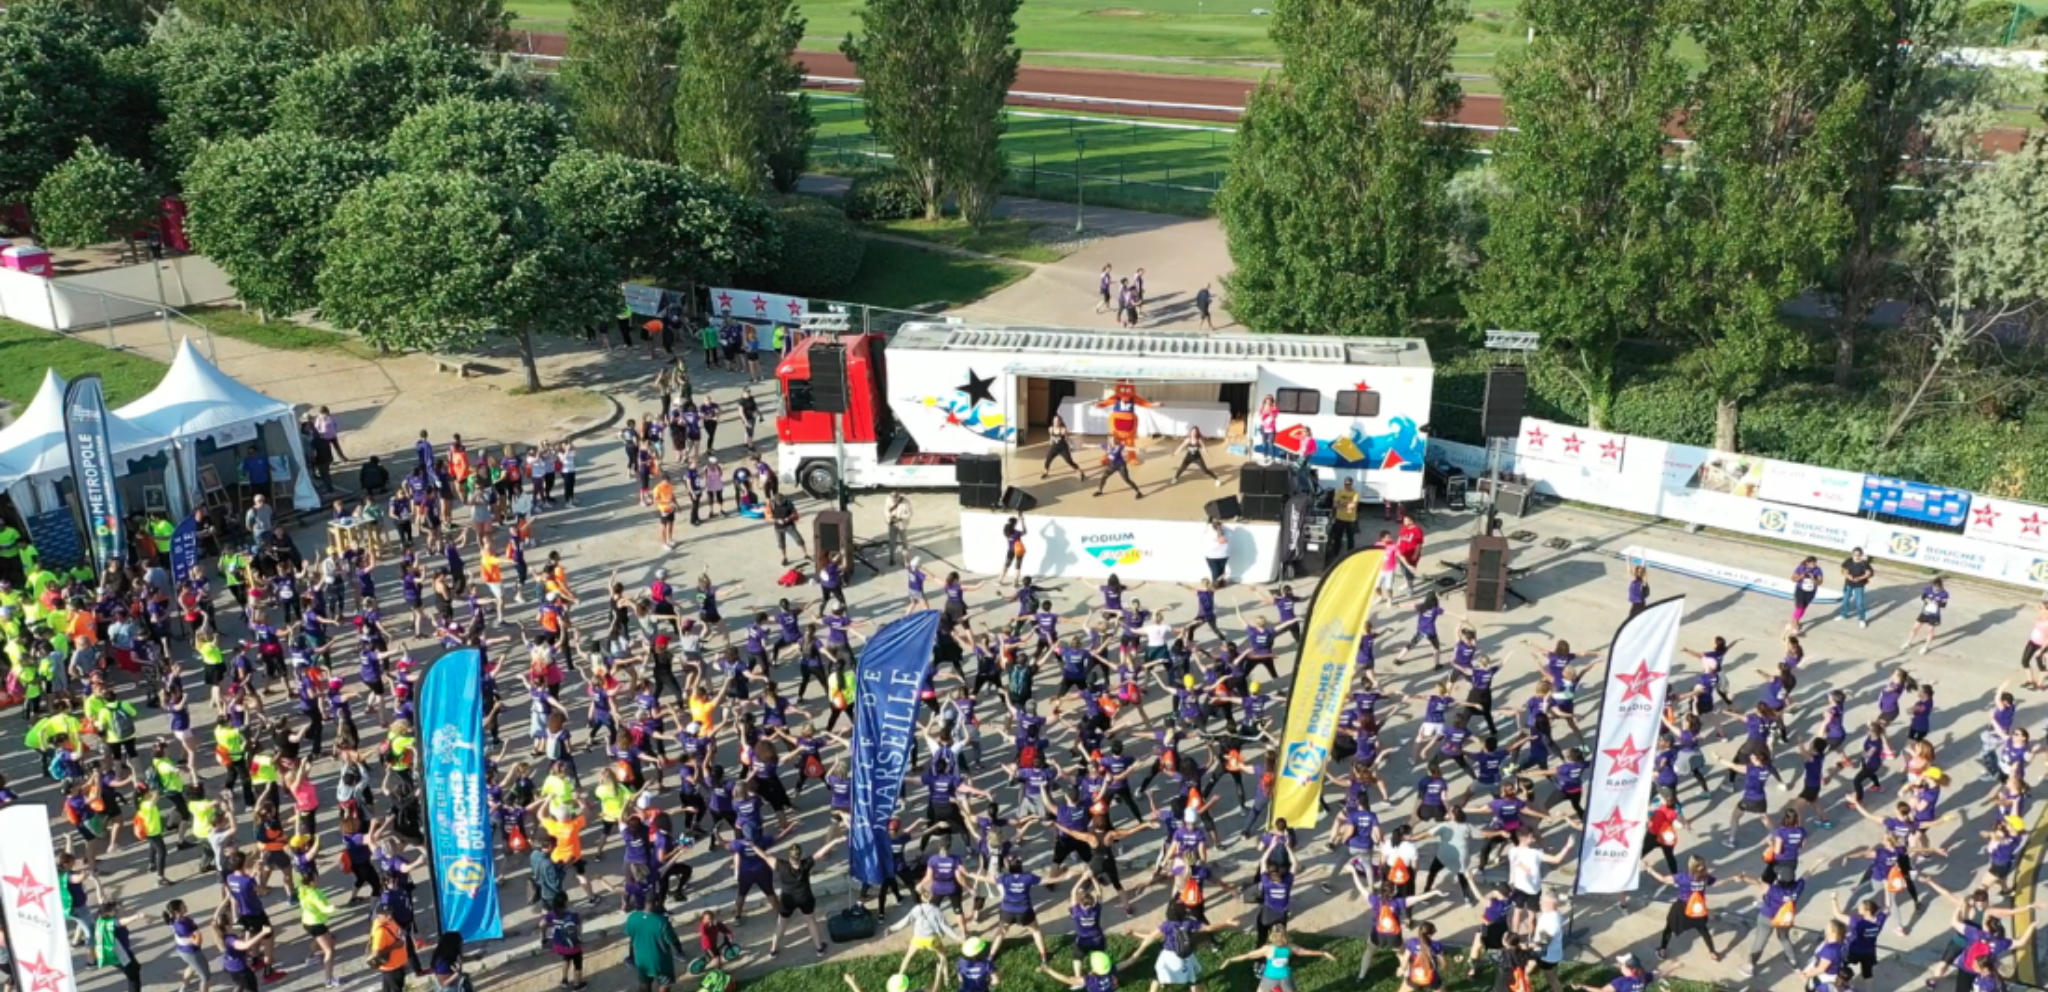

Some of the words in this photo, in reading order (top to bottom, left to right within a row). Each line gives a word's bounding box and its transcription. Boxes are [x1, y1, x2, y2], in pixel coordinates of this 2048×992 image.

[1081, 532, 1135, 543] PODIUM
[1307, 663, 1334, 733] BOUCHES
[1619, 703, 1652, 712] RADIO
[873, 669, 921, 830] MARSEILLE
[449, 769, 470, 849] BOUCHES
[472, 830, 485, 850] DU
[1595, 850, 1628, 858] RADIO
